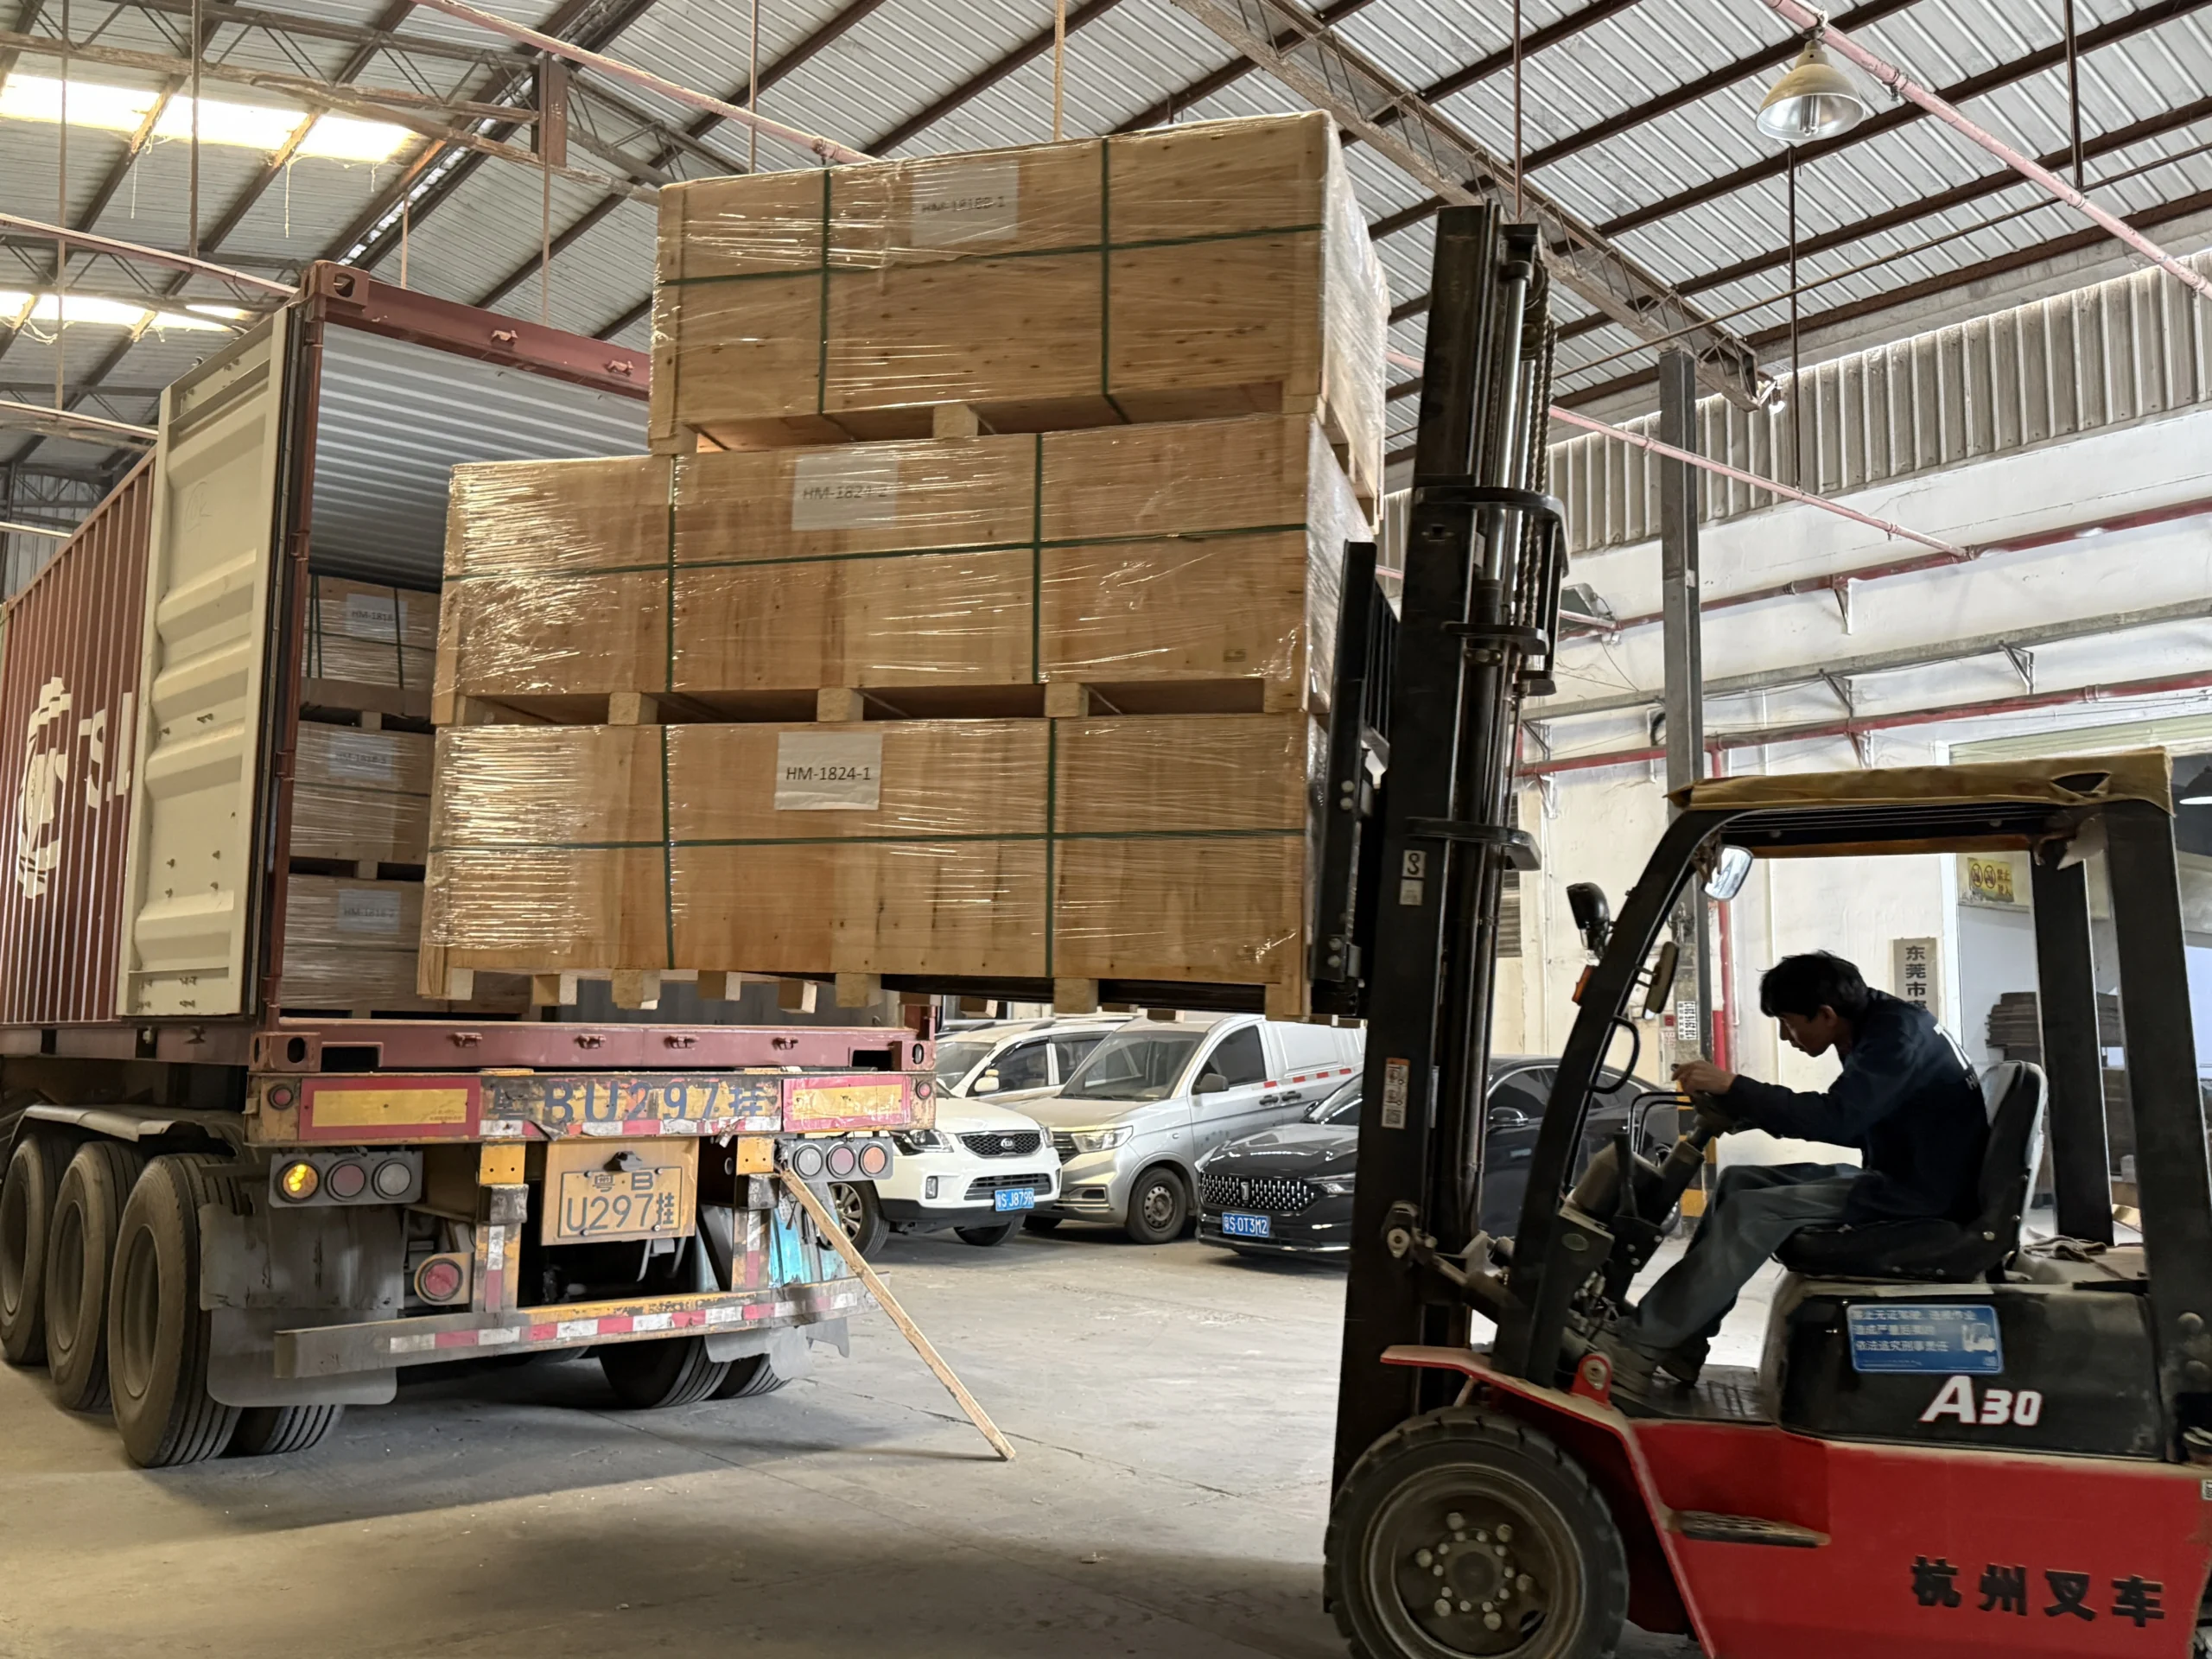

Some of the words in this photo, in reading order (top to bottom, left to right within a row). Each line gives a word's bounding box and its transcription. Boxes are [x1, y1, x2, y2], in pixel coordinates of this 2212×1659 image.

[785, 766, 872, 780] HM-1824-1
[566, 1192, 675, 1232] U297挂
[1918, 1374, 2044, 1427] A30
[1910, 1554, 2166, 1629] 杭州叉车
